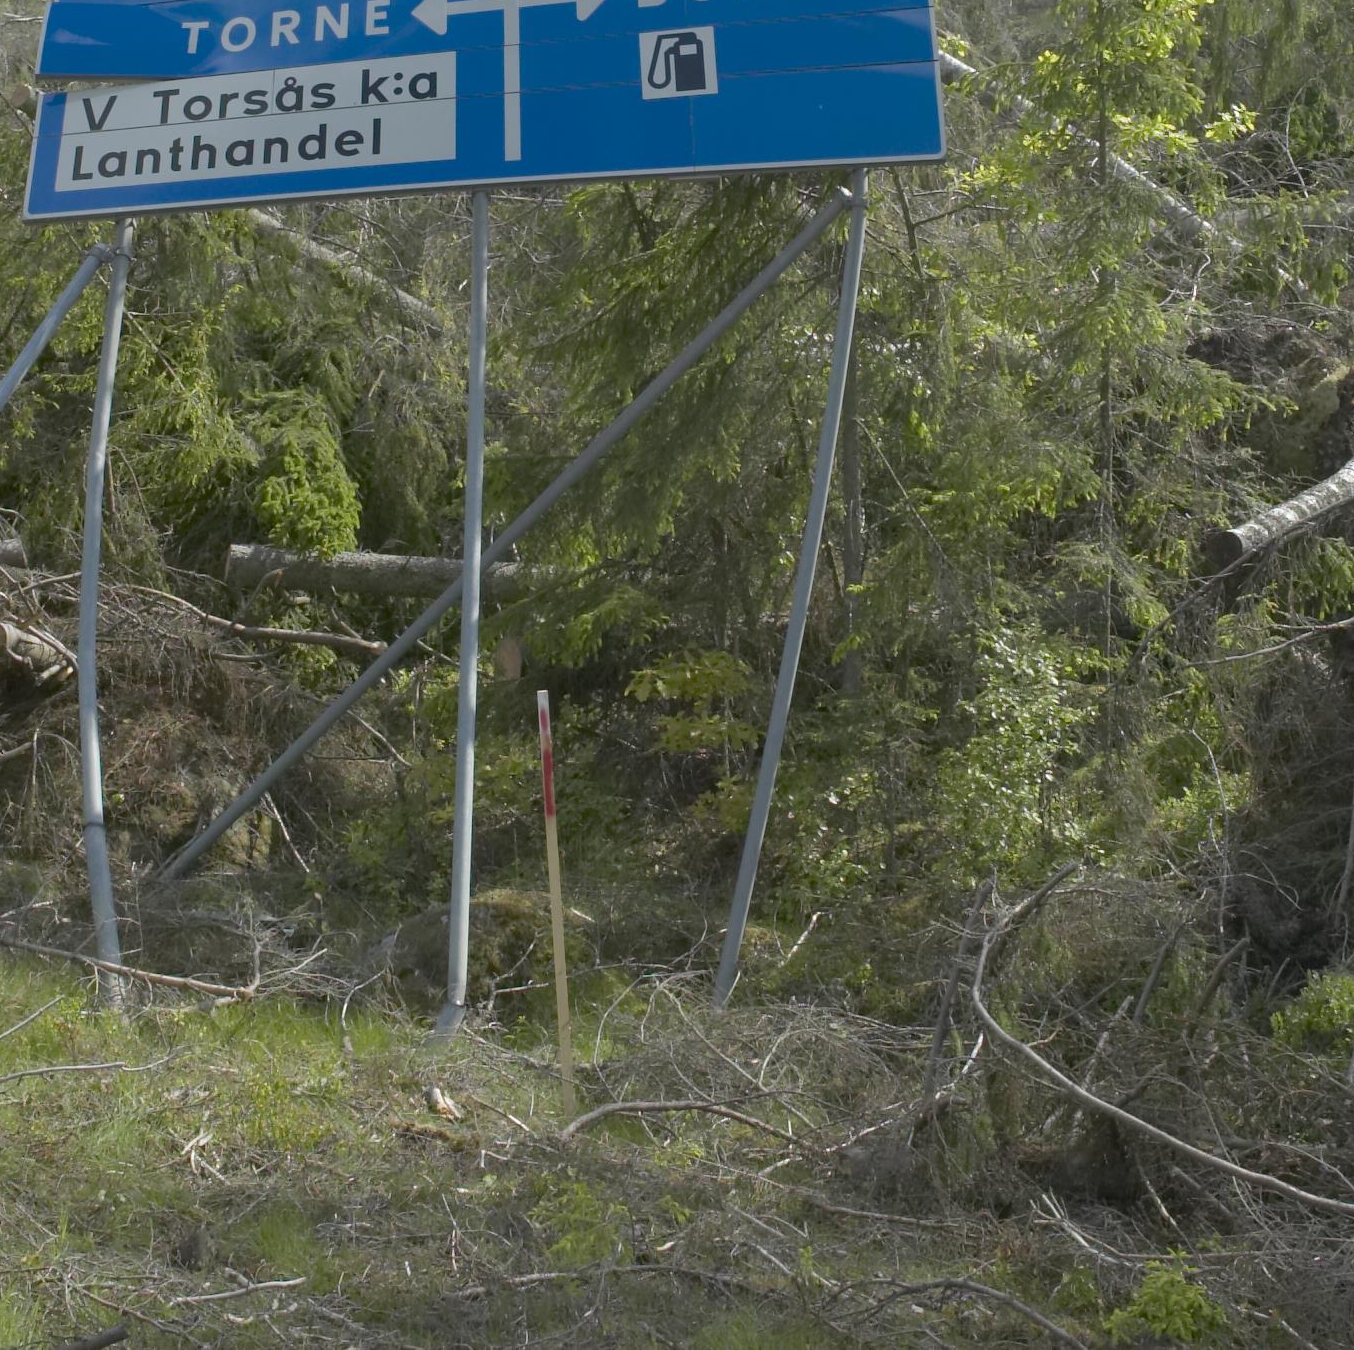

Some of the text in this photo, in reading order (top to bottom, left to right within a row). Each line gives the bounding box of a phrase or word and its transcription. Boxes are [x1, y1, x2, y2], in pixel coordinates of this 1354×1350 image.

[83, 68, 441, 133] V Torsås k:a
[72, 118, 382, 182] Lanthandel
